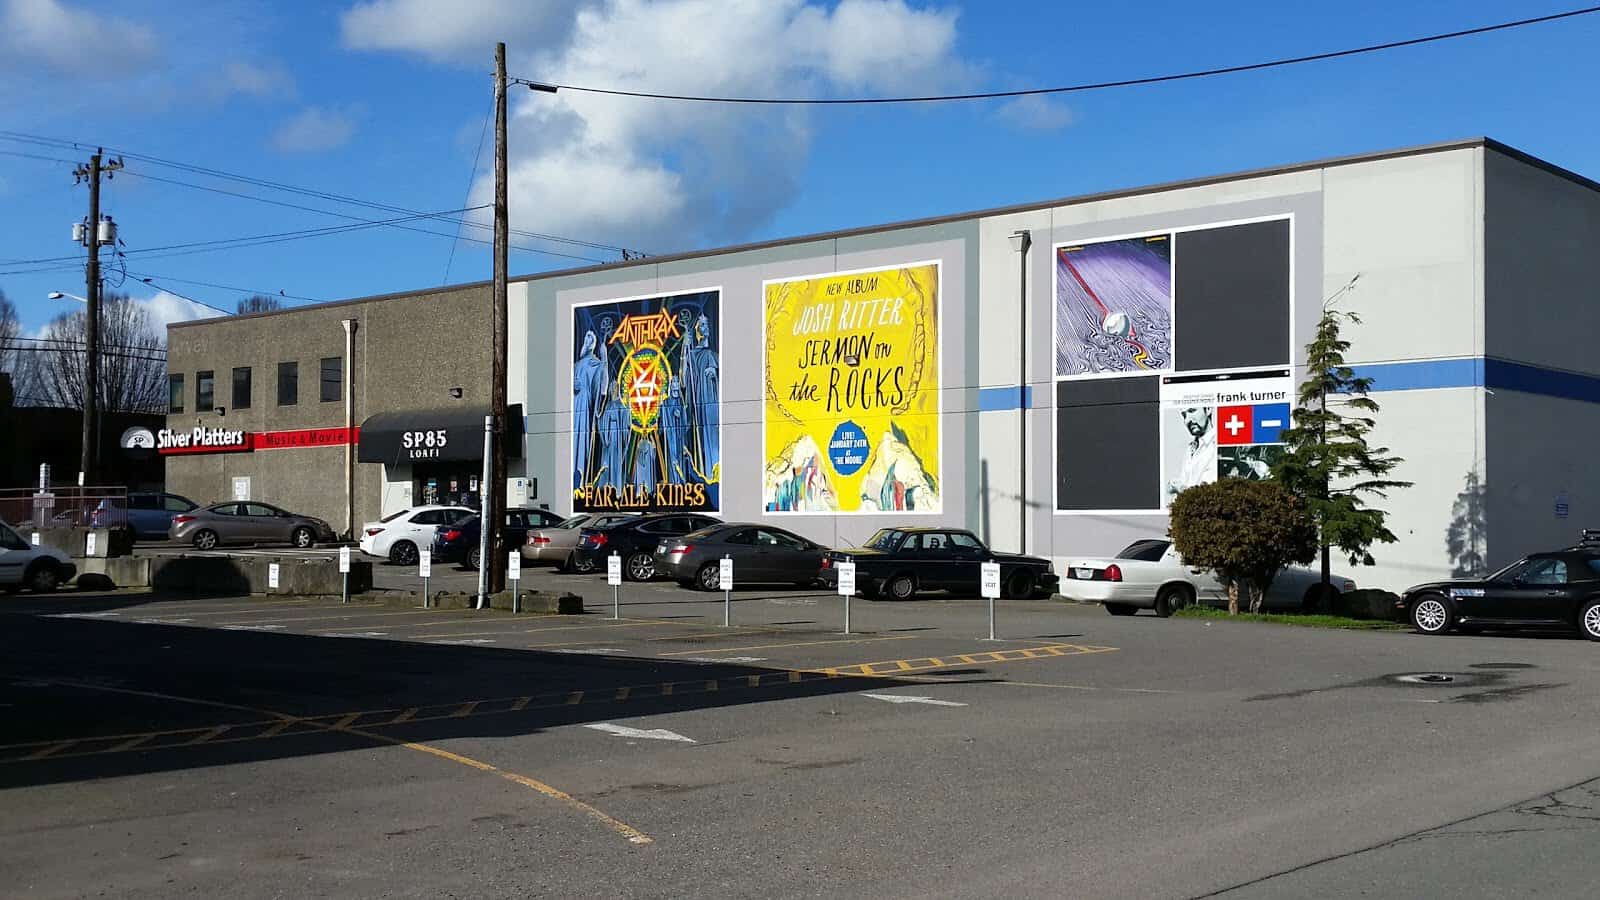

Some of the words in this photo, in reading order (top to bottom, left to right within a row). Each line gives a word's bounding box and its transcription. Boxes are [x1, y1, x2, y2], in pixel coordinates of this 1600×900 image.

[826, 283, 843, 297] NEW
[845, 276, 879, 297] ALBUM
[792, 303, 835, 336] JOSH
[839, 297, 904, 331] RITTER
[608, 307, 680, 352] ANTHRAX
[799, 332, 874, 370] SERMON
[874, 343, 892, 359] on
[789, 373, 821, 402] the
[827, 366, 904, 413] ROCKS
[1216, 391, 1247, 403] frank
[1250, 390, 1287, 402] turner
[157, 429, 192, 449] Silver
[193, 426, 244, 446] Platters
[266, 433, 297, 446] Music
[402, 430, 447, 448] SP85
